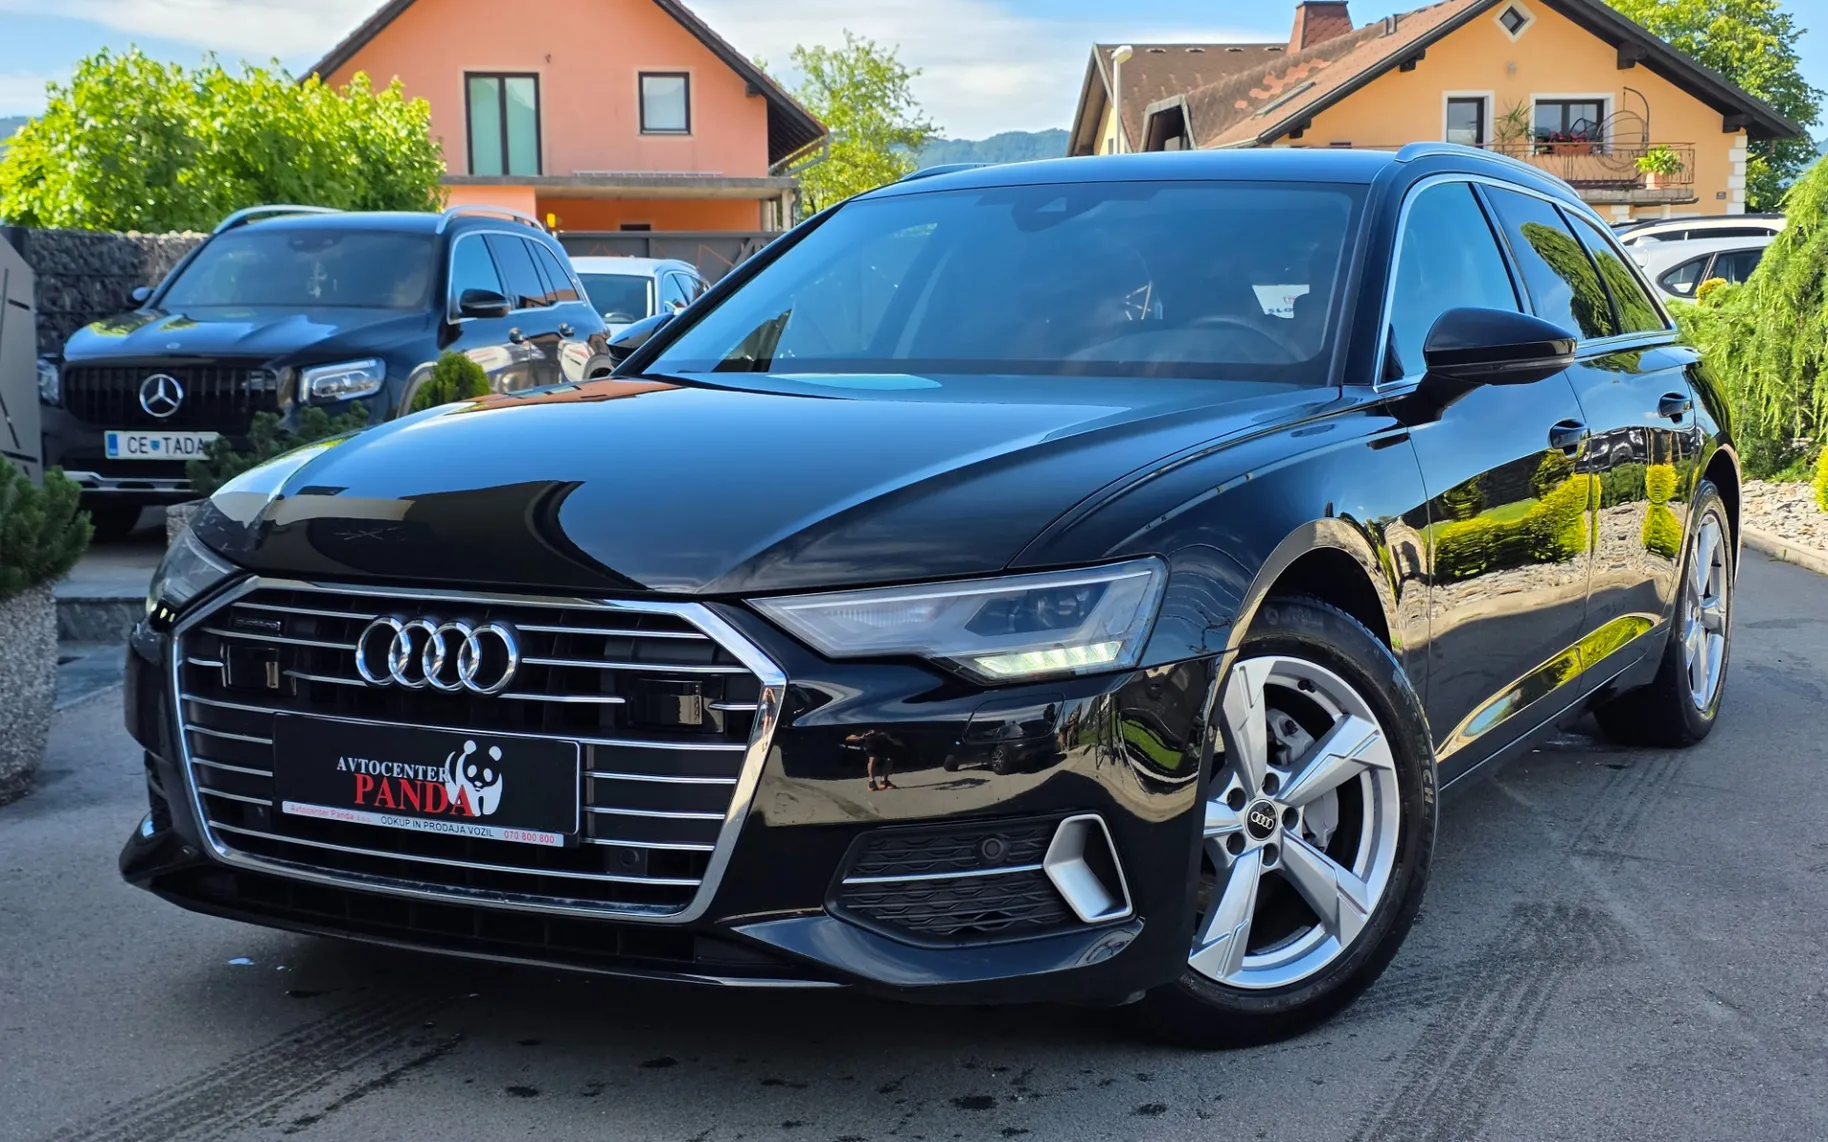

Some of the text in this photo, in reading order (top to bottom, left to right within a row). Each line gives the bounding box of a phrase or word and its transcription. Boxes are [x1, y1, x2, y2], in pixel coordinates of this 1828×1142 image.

[127, 436, 148, 454] CE
[336, 756, 450, 783] AVTOCENTER
[353, 773, 475, 817] PANDA
[380, 815, 555, 844] ODKUP IN PRODAJA VOZIL 070 800 800
